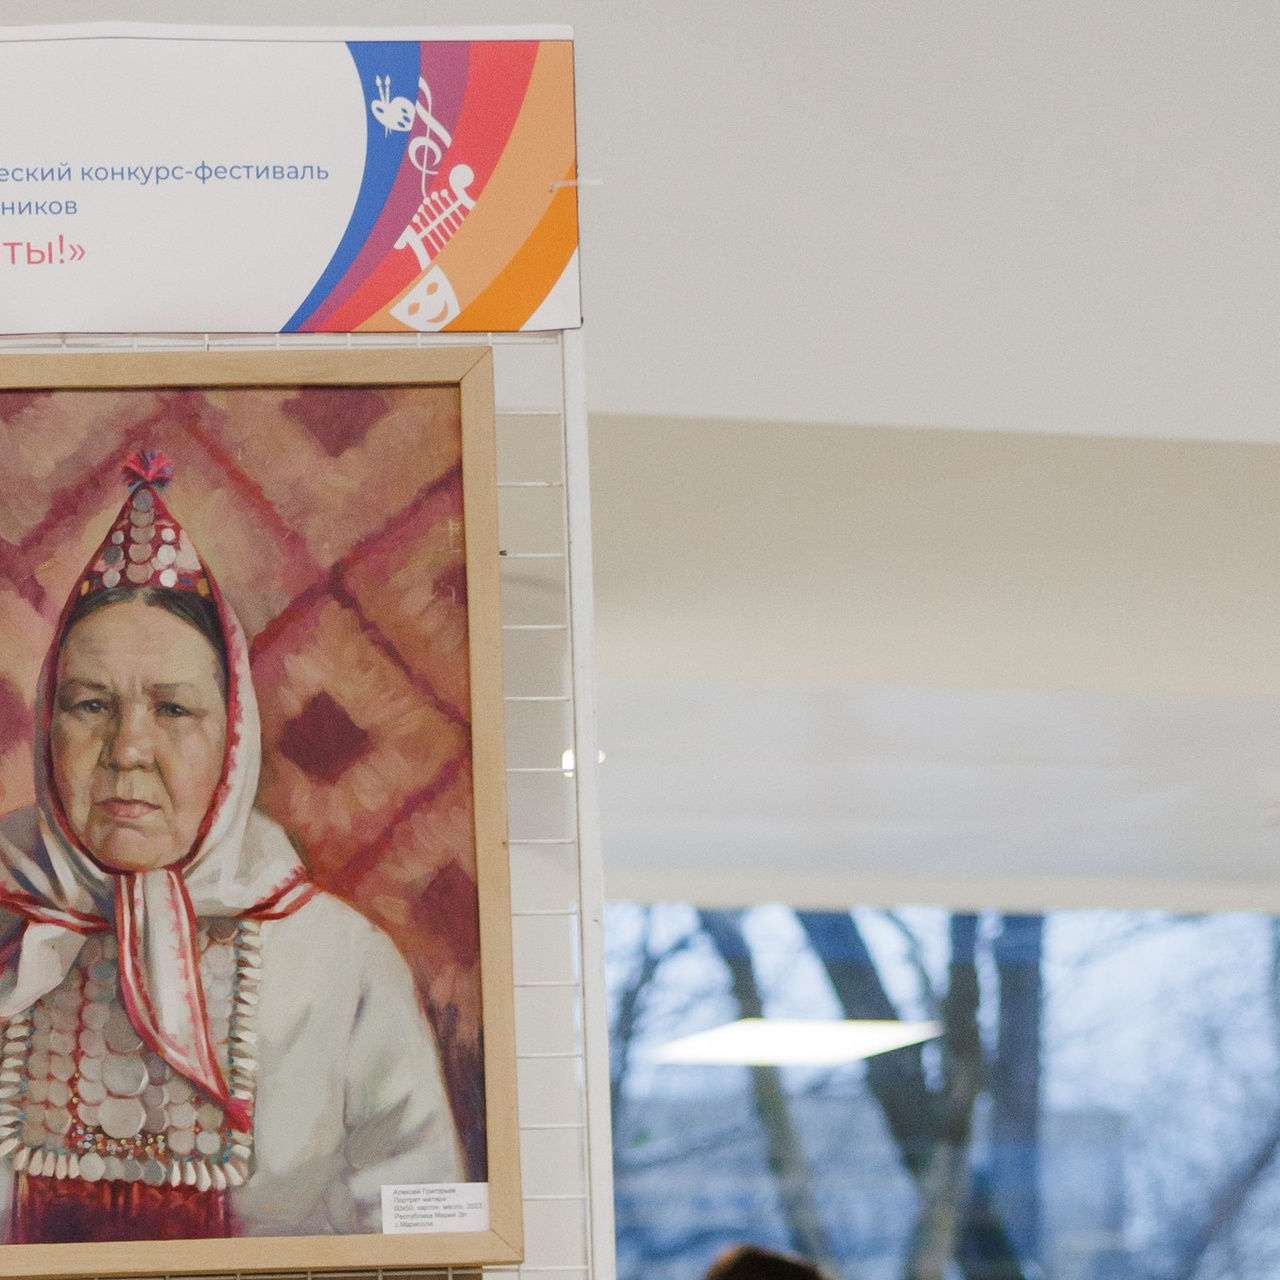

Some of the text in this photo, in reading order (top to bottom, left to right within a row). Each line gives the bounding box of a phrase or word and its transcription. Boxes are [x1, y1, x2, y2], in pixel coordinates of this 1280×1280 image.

[80, 160, 330, 185] конкурс-фестиваль
[394, 1196, 421, 1204] Портрет
[393, 1212, 433, 1221] Республика
